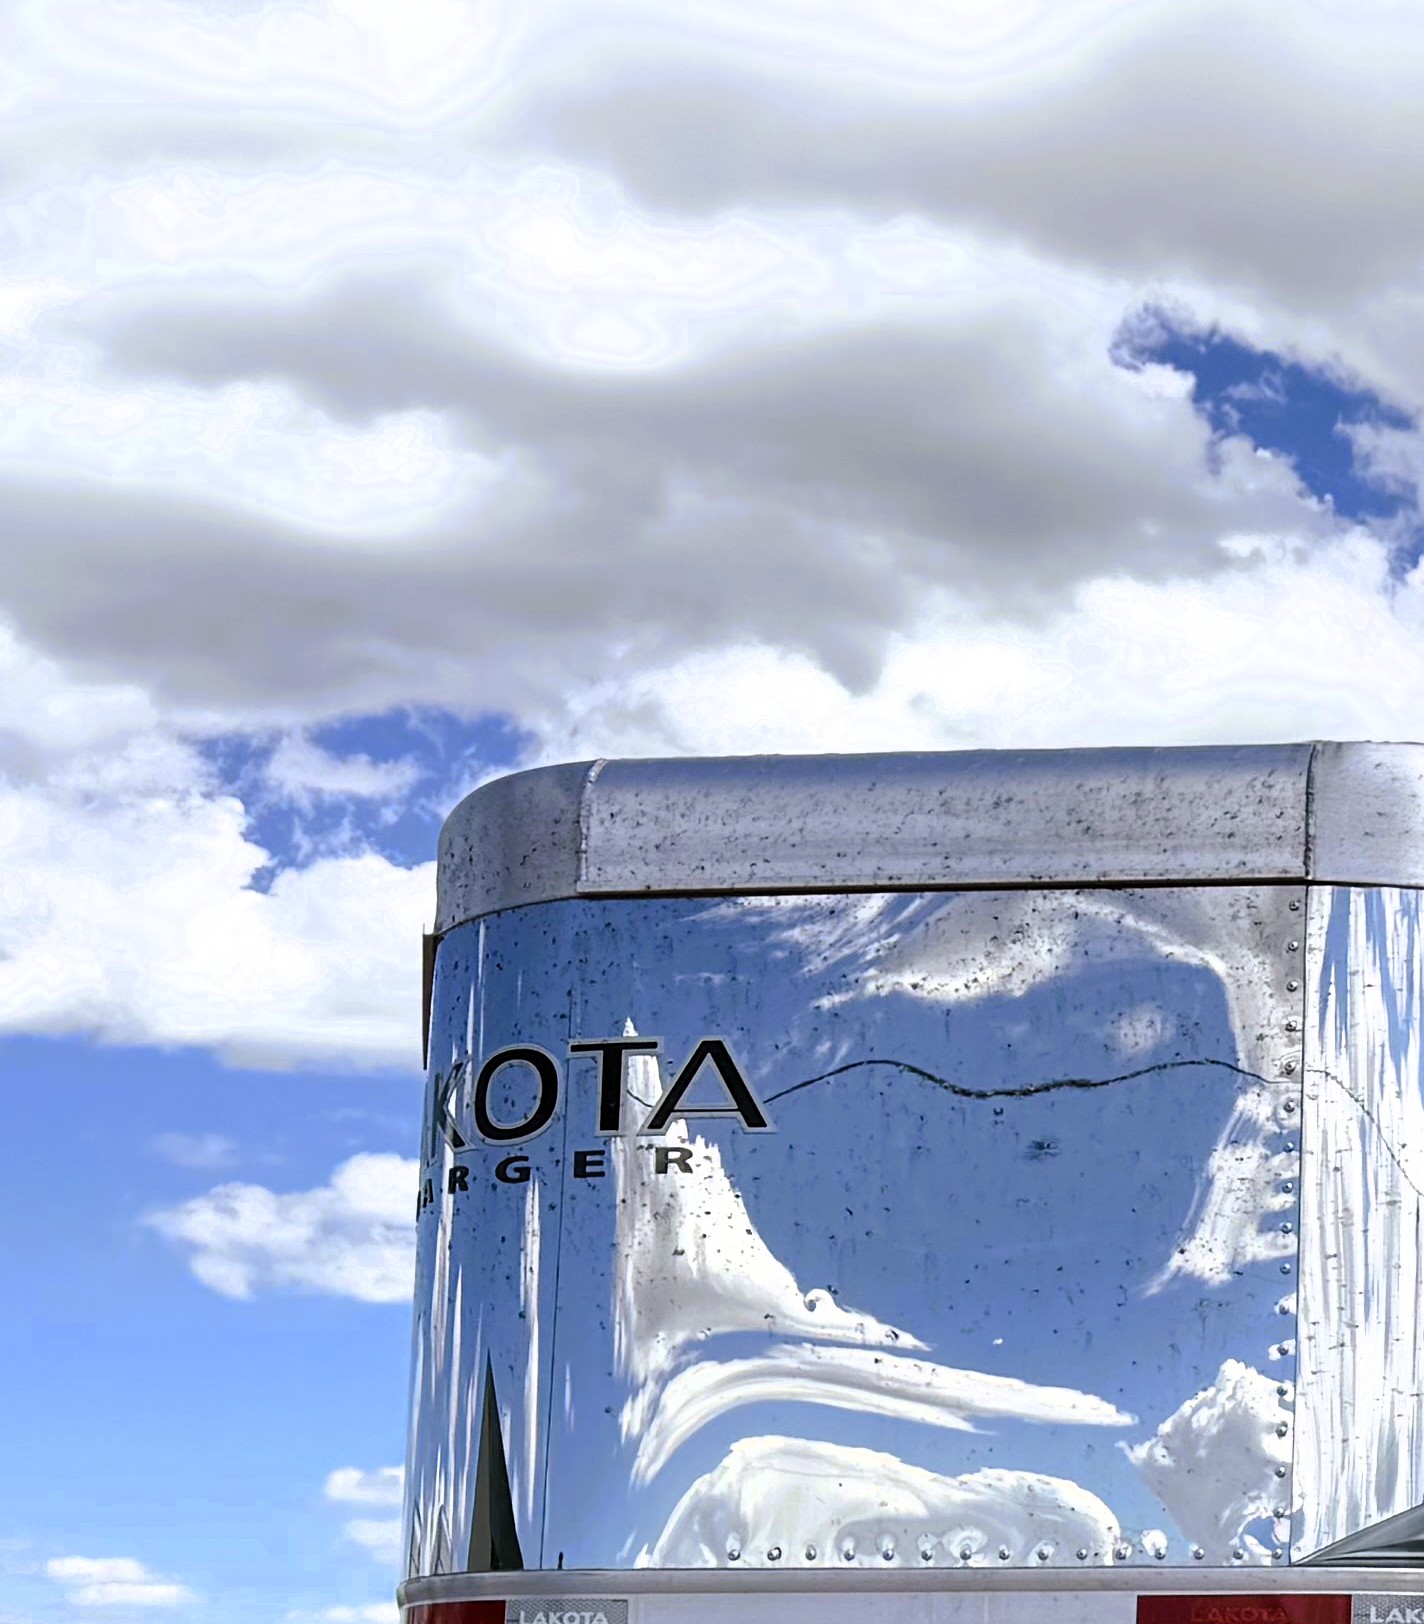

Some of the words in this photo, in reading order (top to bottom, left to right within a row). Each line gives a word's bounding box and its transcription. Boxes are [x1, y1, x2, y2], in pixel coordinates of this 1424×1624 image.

[424, 1037, 777, 1166] KOTA
[416, 1146, 693, 1220] ARGER
[1190, 1604, 1290, 1624] LAKOTA
